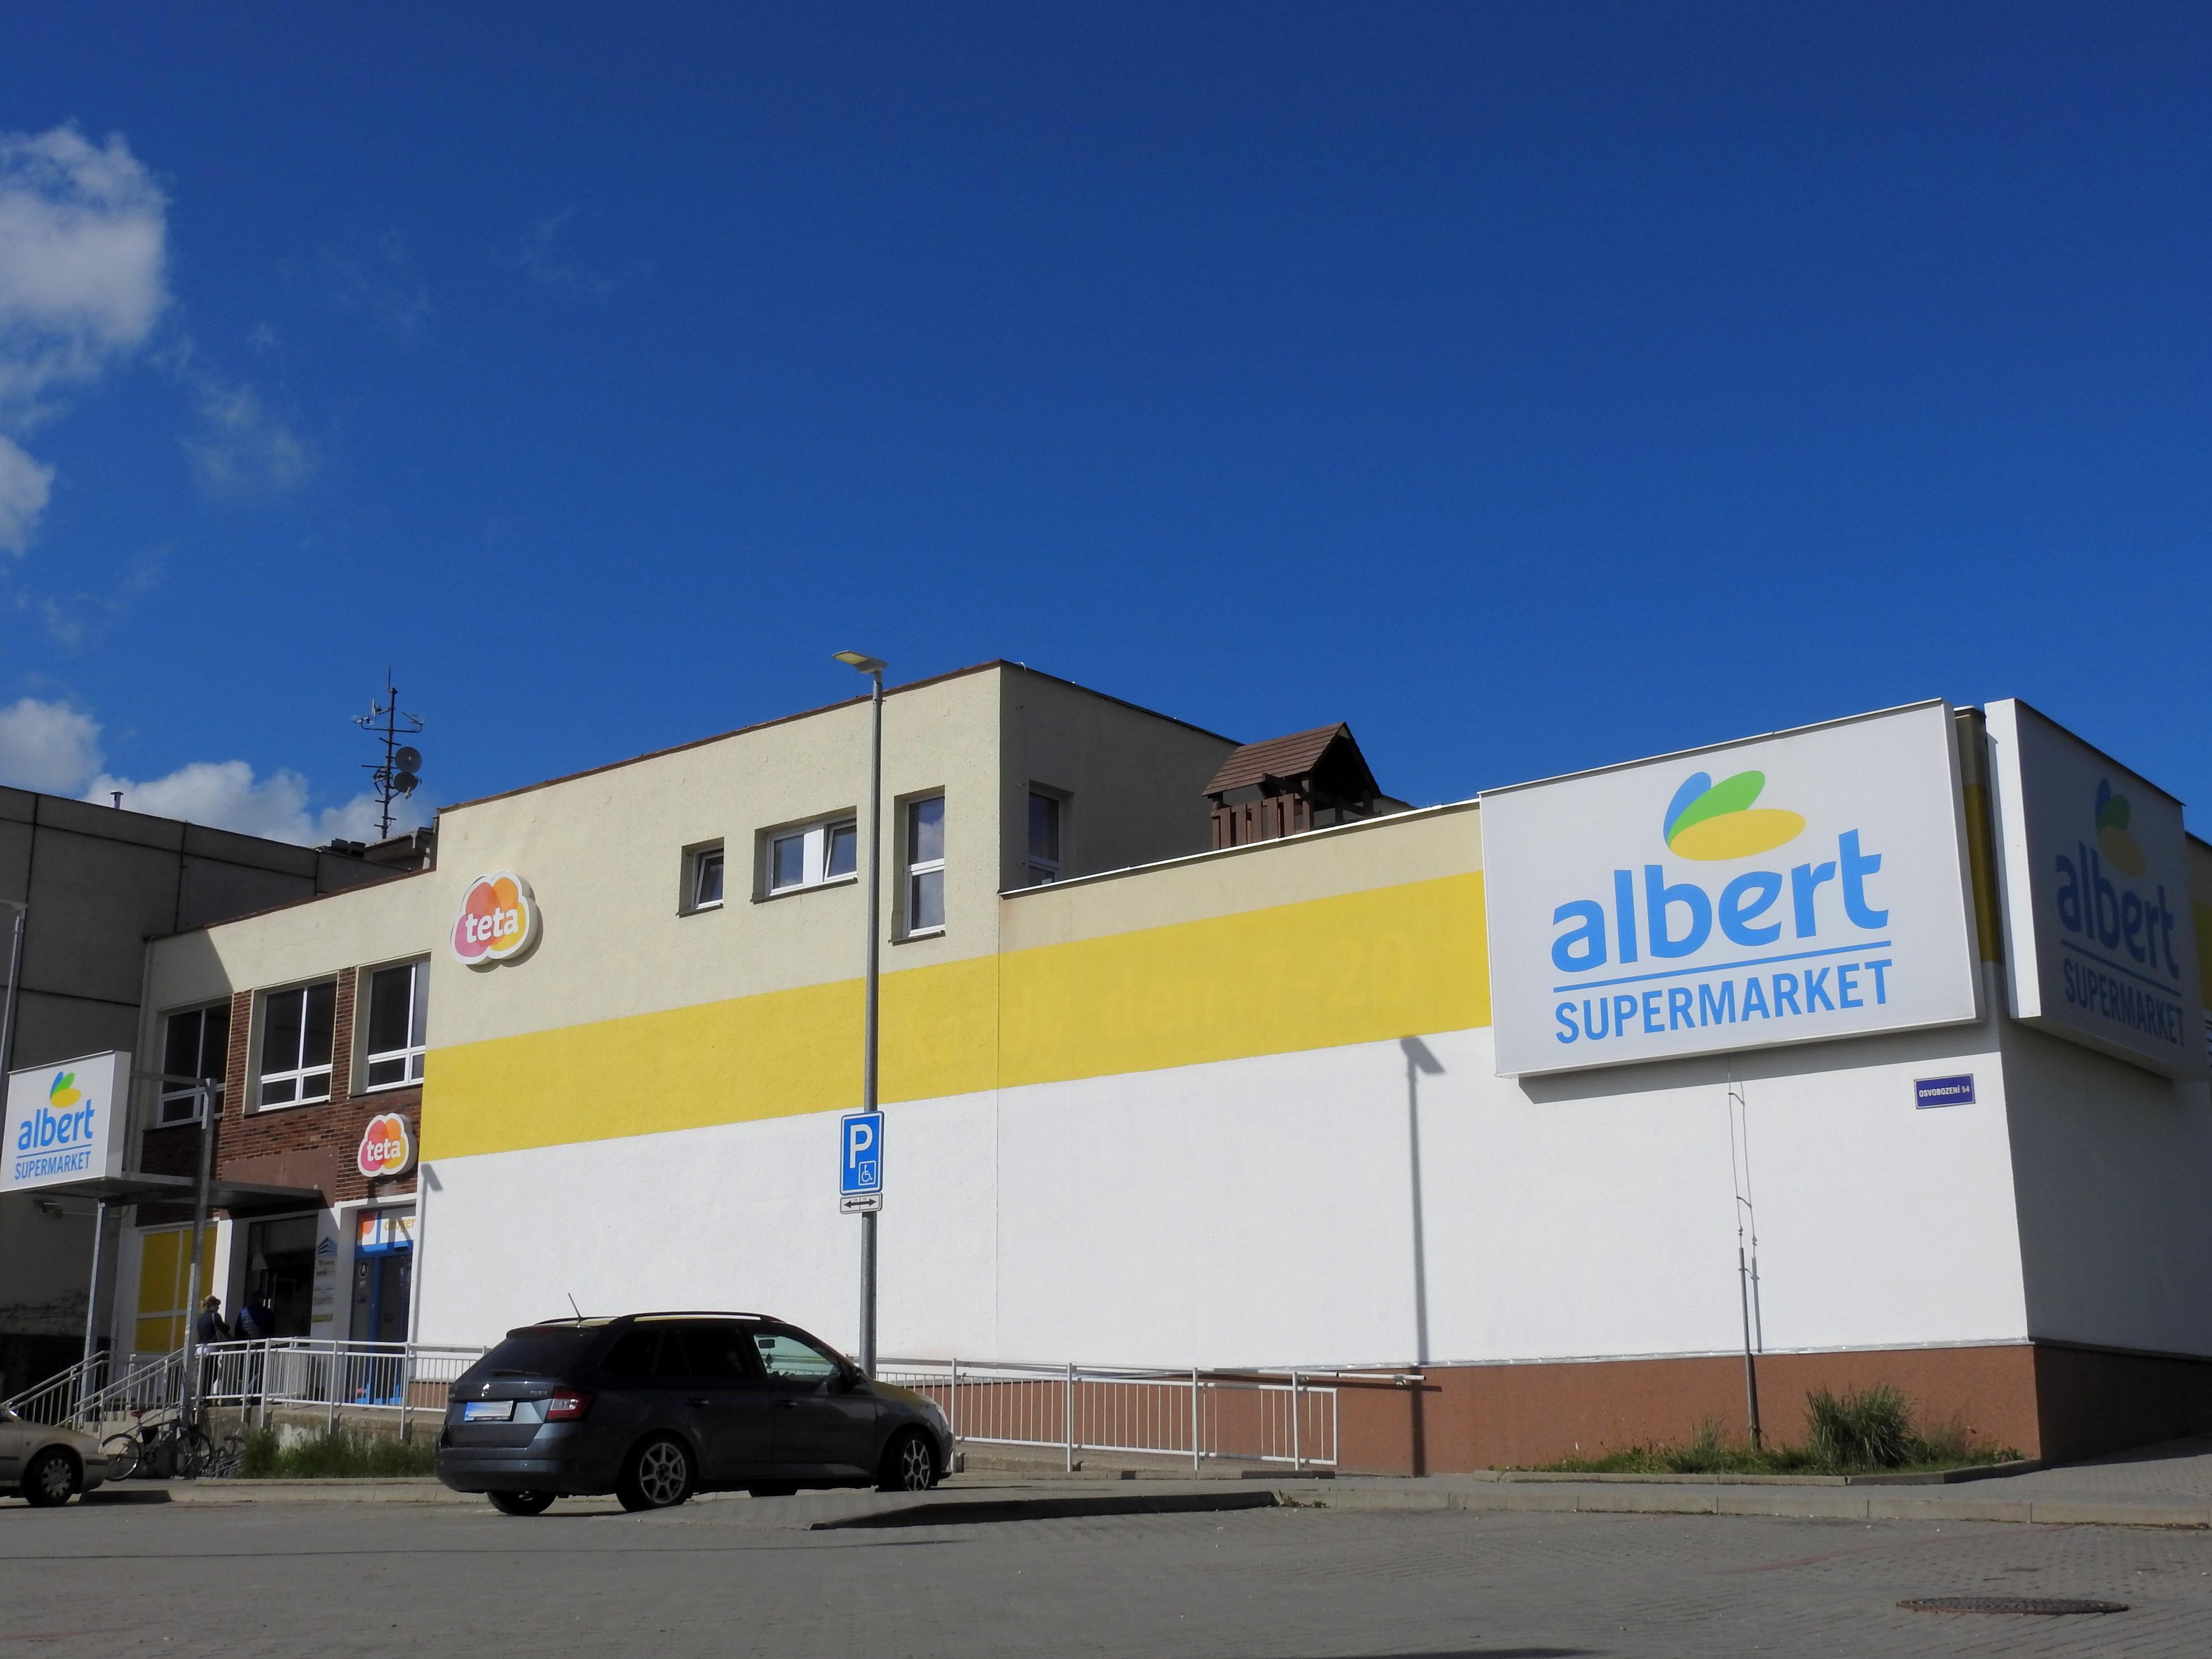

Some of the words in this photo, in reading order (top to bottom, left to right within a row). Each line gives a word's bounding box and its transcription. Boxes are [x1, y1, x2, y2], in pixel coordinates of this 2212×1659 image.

[1551, 828, 1889, 973] albert
[2055, 841, 2179, 980] albert
[465, 907, 519, 943] teta
[1555, 959, 1892, 1044] SUPERMARKET
[2063, 958, 2185, 1047] SUPERMARKET
[1918, 1084, 1960, 1097] OSVOBOZENÍ
[18, 1099, 95, 1150] albert
[849, 1124, 873, 1168] P
[15, 1151, 91, 1180] SUPERMARKET
[367, 1138, 401, 1161] teta
